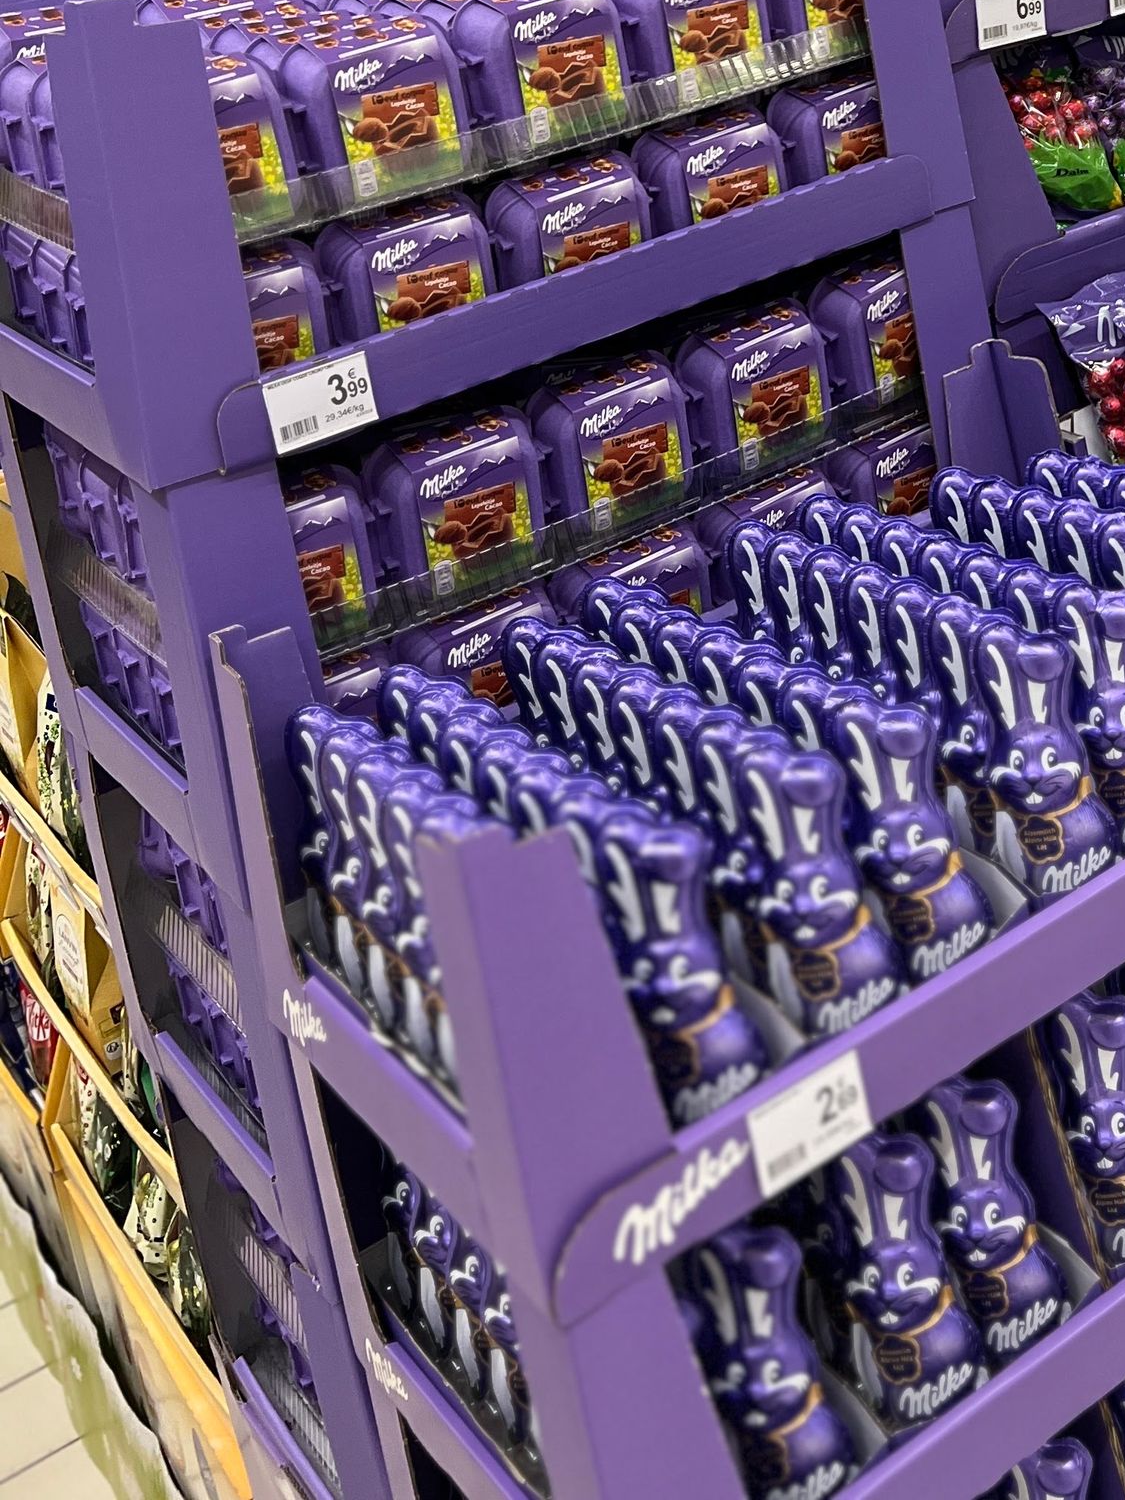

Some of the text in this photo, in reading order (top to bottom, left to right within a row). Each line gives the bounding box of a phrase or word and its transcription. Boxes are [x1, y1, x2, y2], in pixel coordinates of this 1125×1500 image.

[514, 11, 556, 41] Milka
[17, 42, 45, 58] Mil
[334, 59, 382, 91] Milka
[822, 100, 857, 129] Milka
[686, 145, 725, 174] Milka
[542, 201, 585, 235] Milka
[372, 239, 418, 272] Milka
[867, 290, 899, 321] Milka
[732, 350, 769, 382] Milka
[580, 405, 622, 437] Milka
[876, 447, 909, 477] Milka
[420, 465, 466, 499] Milka
[447, 632, 492, 669] Milka
[1042, 846, 1111, 893] Milka
[913, 921, 984, 977] Milka
[283, 989, 326, 1047] Milka
[818, 977, 893, 1034] Milka
[674, 1064, 759, 1124] Milka
[613, 1139, 747, 1265] Milka
[988, 1299, 1059, 1351] Milka
[366, 1338, 408, 1400] Milka
[900, 1361, 972, 1417] Milka
[765, 1460, 845, 1500] Milka
